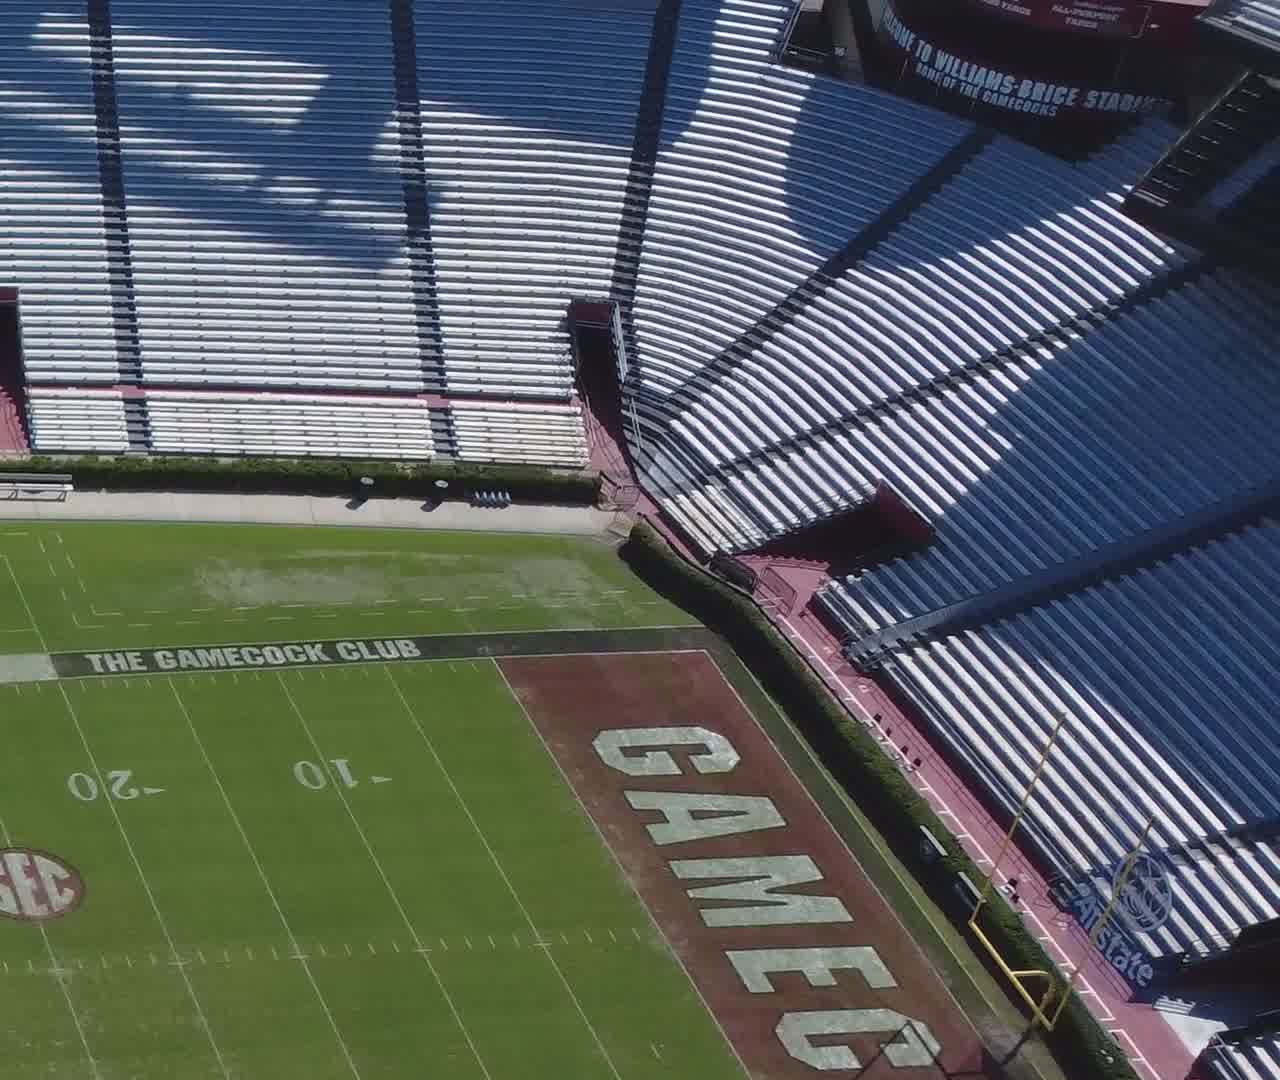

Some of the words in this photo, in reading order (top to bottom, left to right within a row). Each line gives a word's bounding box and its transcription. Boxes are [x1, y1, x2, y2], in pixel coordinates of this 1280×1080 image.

[916, 39, 933, 63] TO
[1083, 90, 1175, 113] STADI
[982, 90, 1057, 118] GAMECOCKS
[84, 650, 149, 674] THE
[152, 643, 334, 670] GAMECOCK
[335, 638, 423, 662] CLUB
[68, 769, 139, 801] 20
[293, 759, 360, 791] 10
